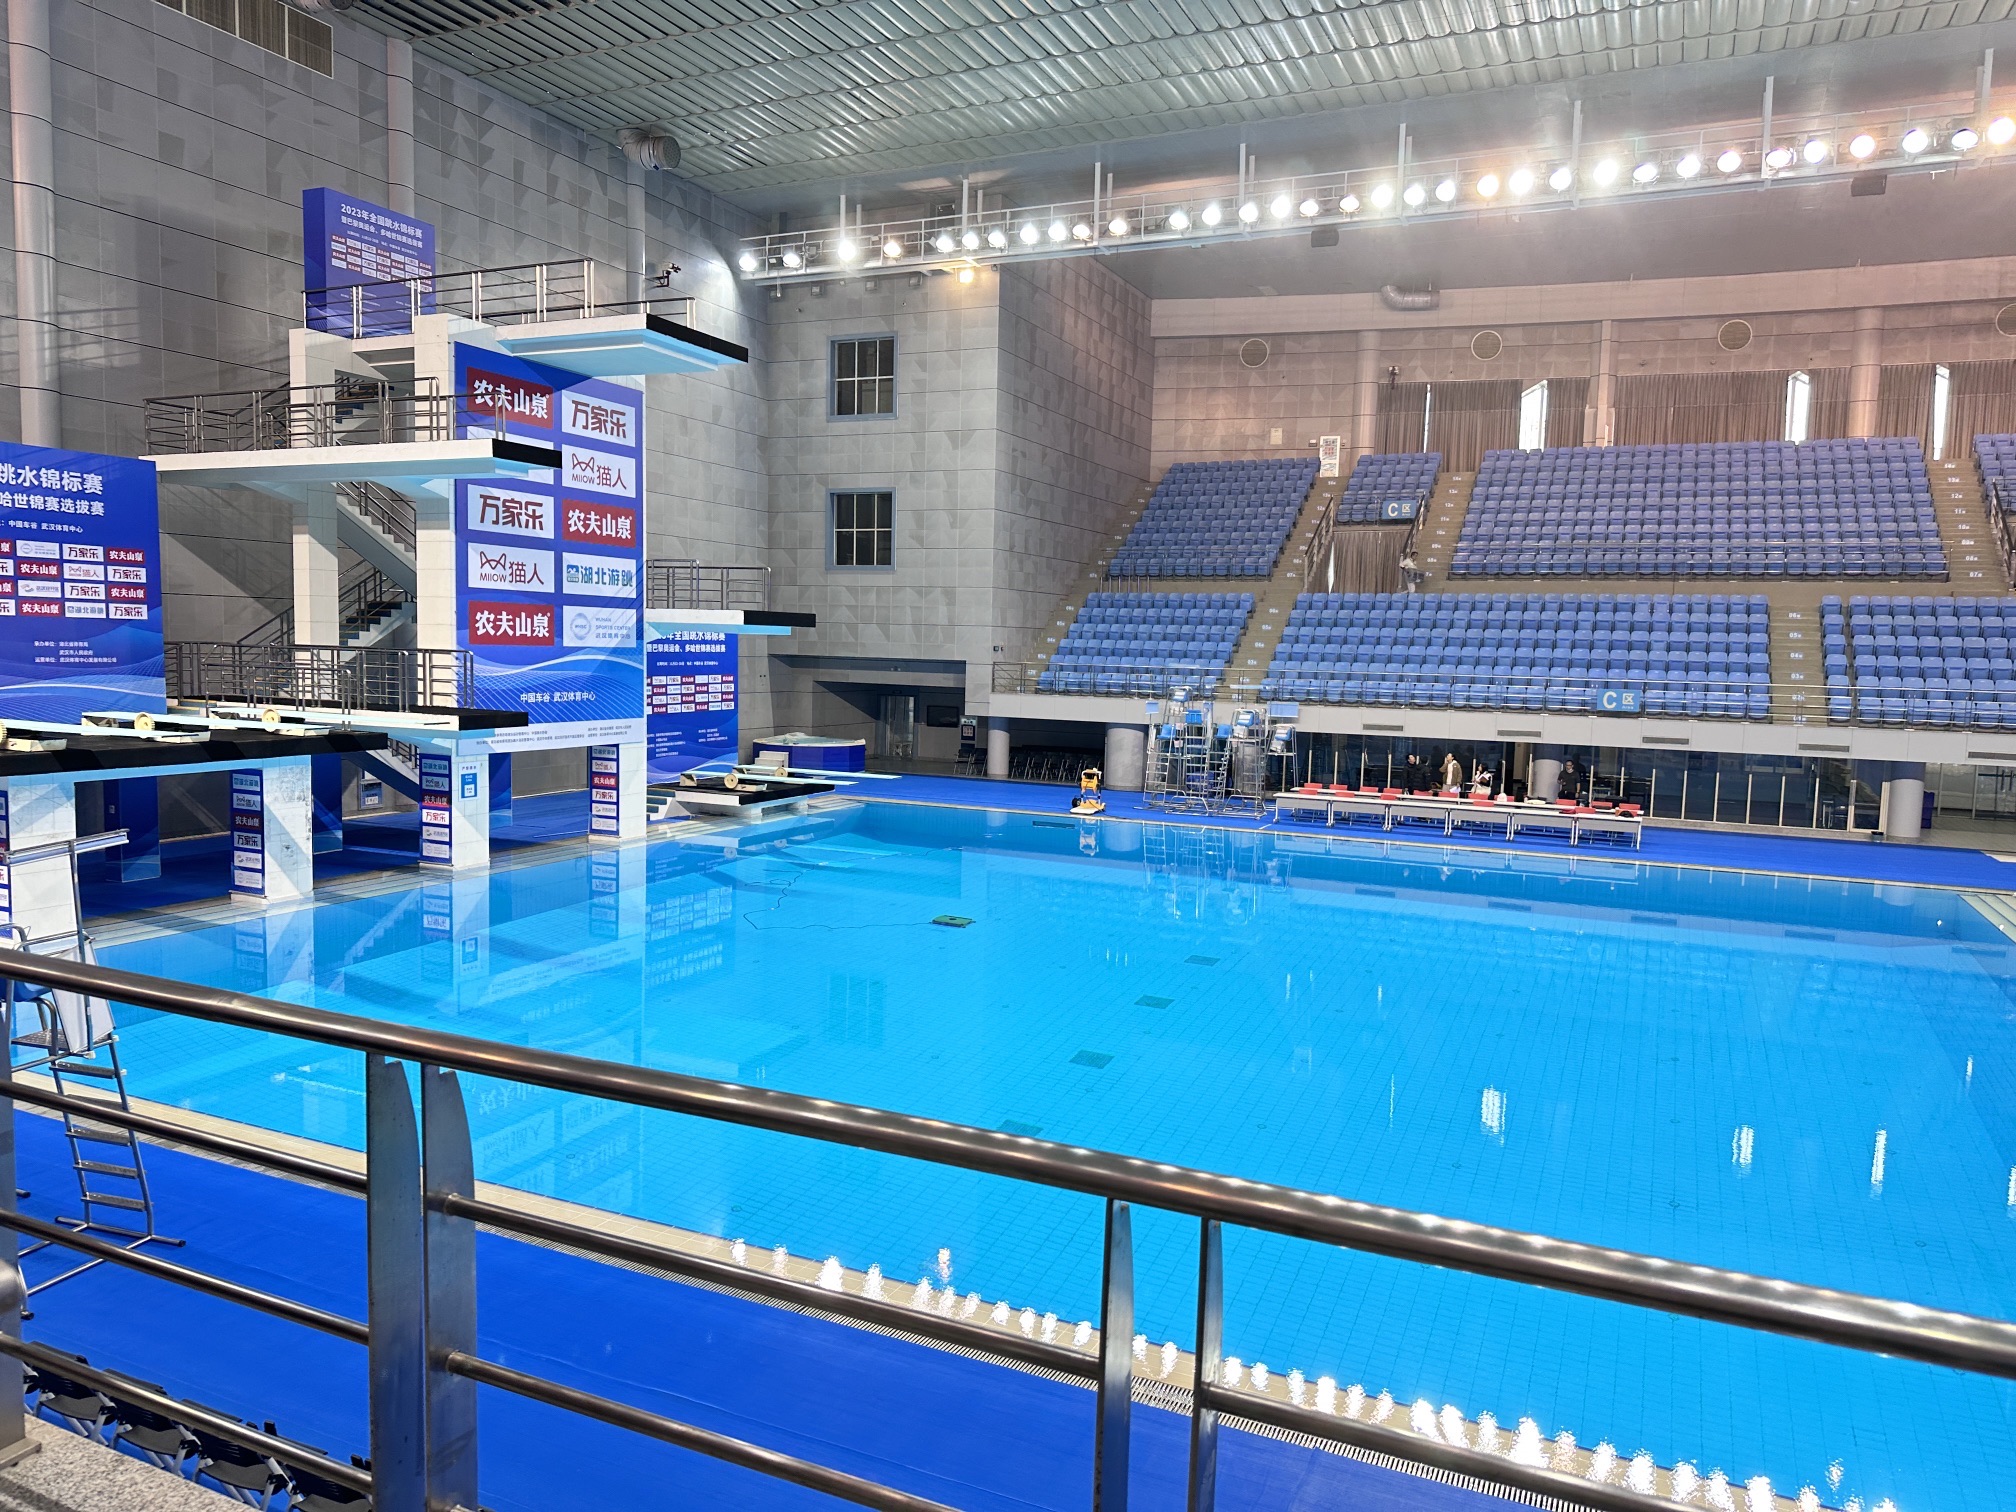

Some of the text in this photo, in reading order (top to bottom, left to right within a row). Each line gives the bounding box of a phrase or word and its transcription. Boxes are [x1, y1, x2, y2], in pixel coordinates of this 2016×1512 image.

[473, 379, 548, 419] 农夫山泉
[572, 400, 627, 438] 万家乐
[596, 464, 627, 490] 猫人
[479, 494, 544, 531] 万家乐
[1388, 503, 1399, 516] C
[567, 508, 632, 540] 农夫山泉
[68, 547, 99, 559] 万家乐
[109, 550, 144, 561] 农夫山泉
[20, 564, 58, 575] 农夫山泉
[112, 569, 143, 580] 万家乐
[508, 561, 544, 585] 猫人
[70, 586, 100, 597] 万家乐
[111, 588, 144, 598] 农夫山泉
[22, 603, 59, 614] 农夫山泉
[114, 606, 143, 617] 万家乐
[475, 610, 550, 638] 农夫山泉
[520, 691, 596, 703] 中国车谷 武汉体育中心
[1603, 691, 1617, 709] C
[425, 811, 446, 822] 万家乐
[237, 834, 258, 847] 万家乐
